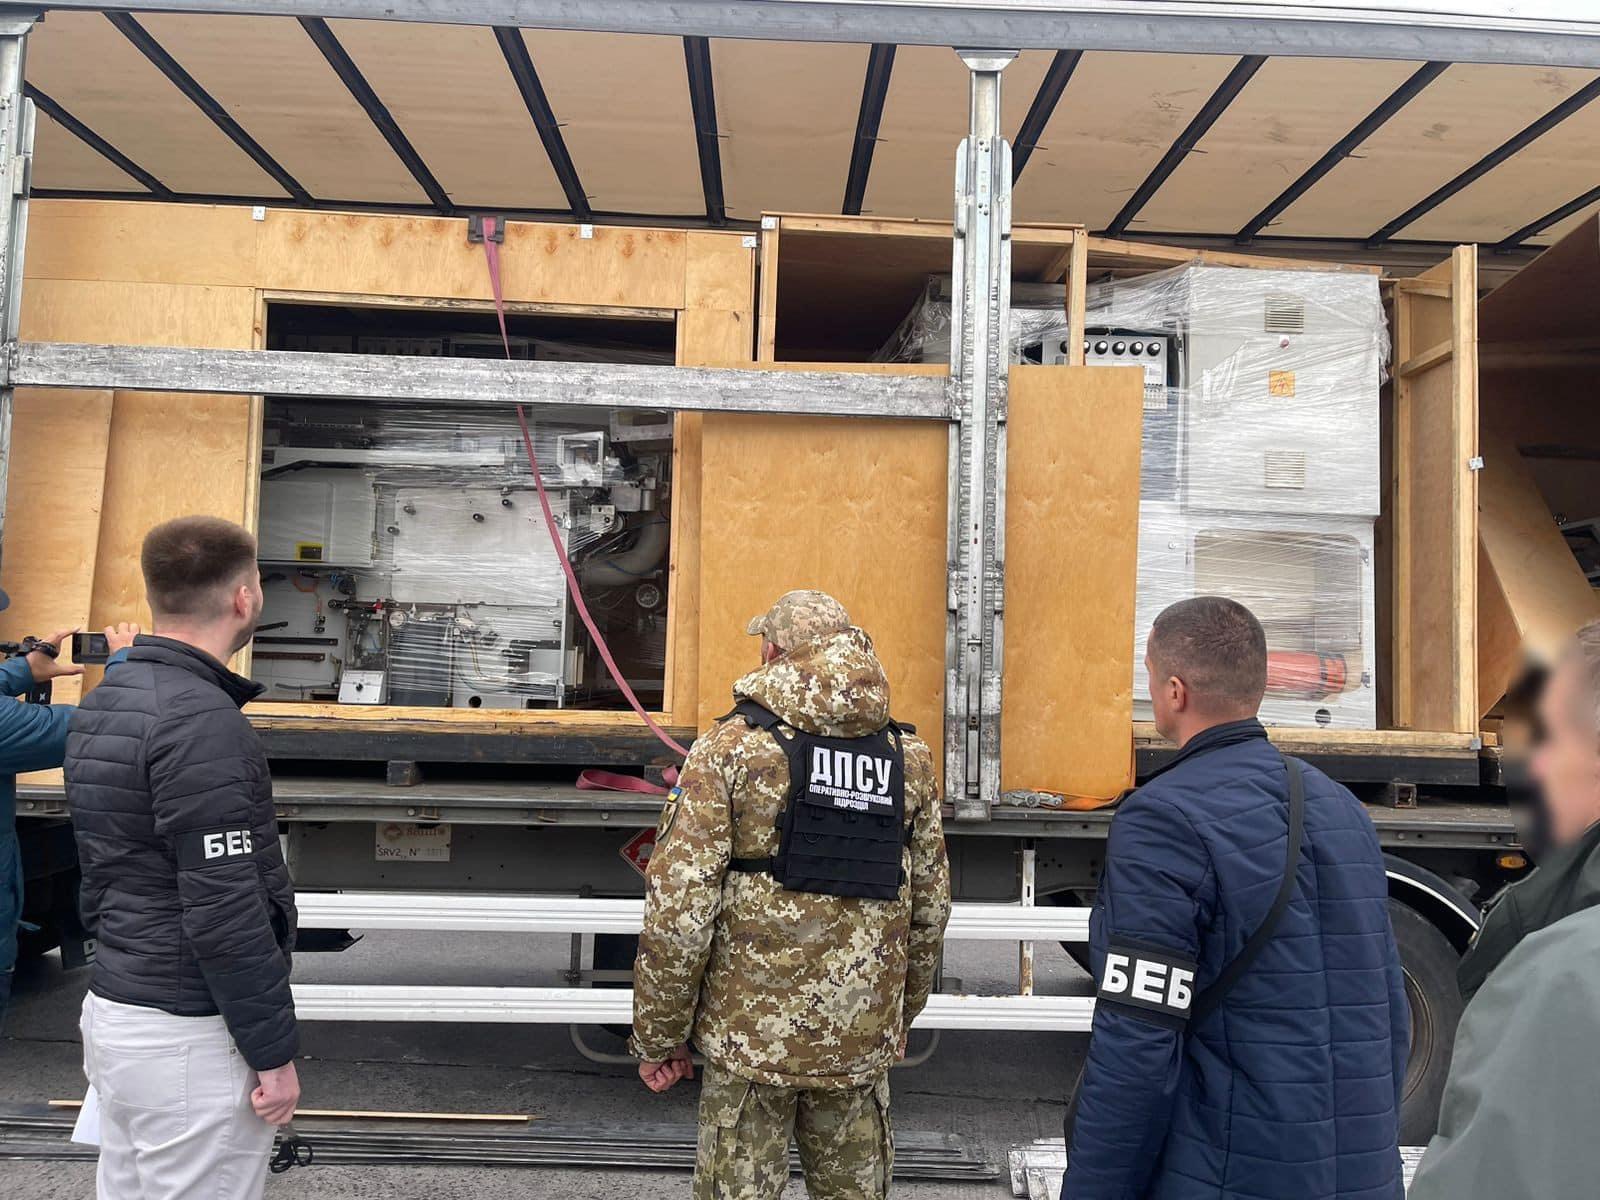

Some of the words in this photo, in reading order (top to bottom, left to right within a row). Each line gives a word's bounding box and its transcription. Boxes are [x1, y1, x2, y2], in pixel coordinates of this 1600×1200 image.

[811, 746, 892, 795] ДПСУ
[203, 830, 252, 859] БЕБ
[1102, 953, 1194, 1009] БЕБ
